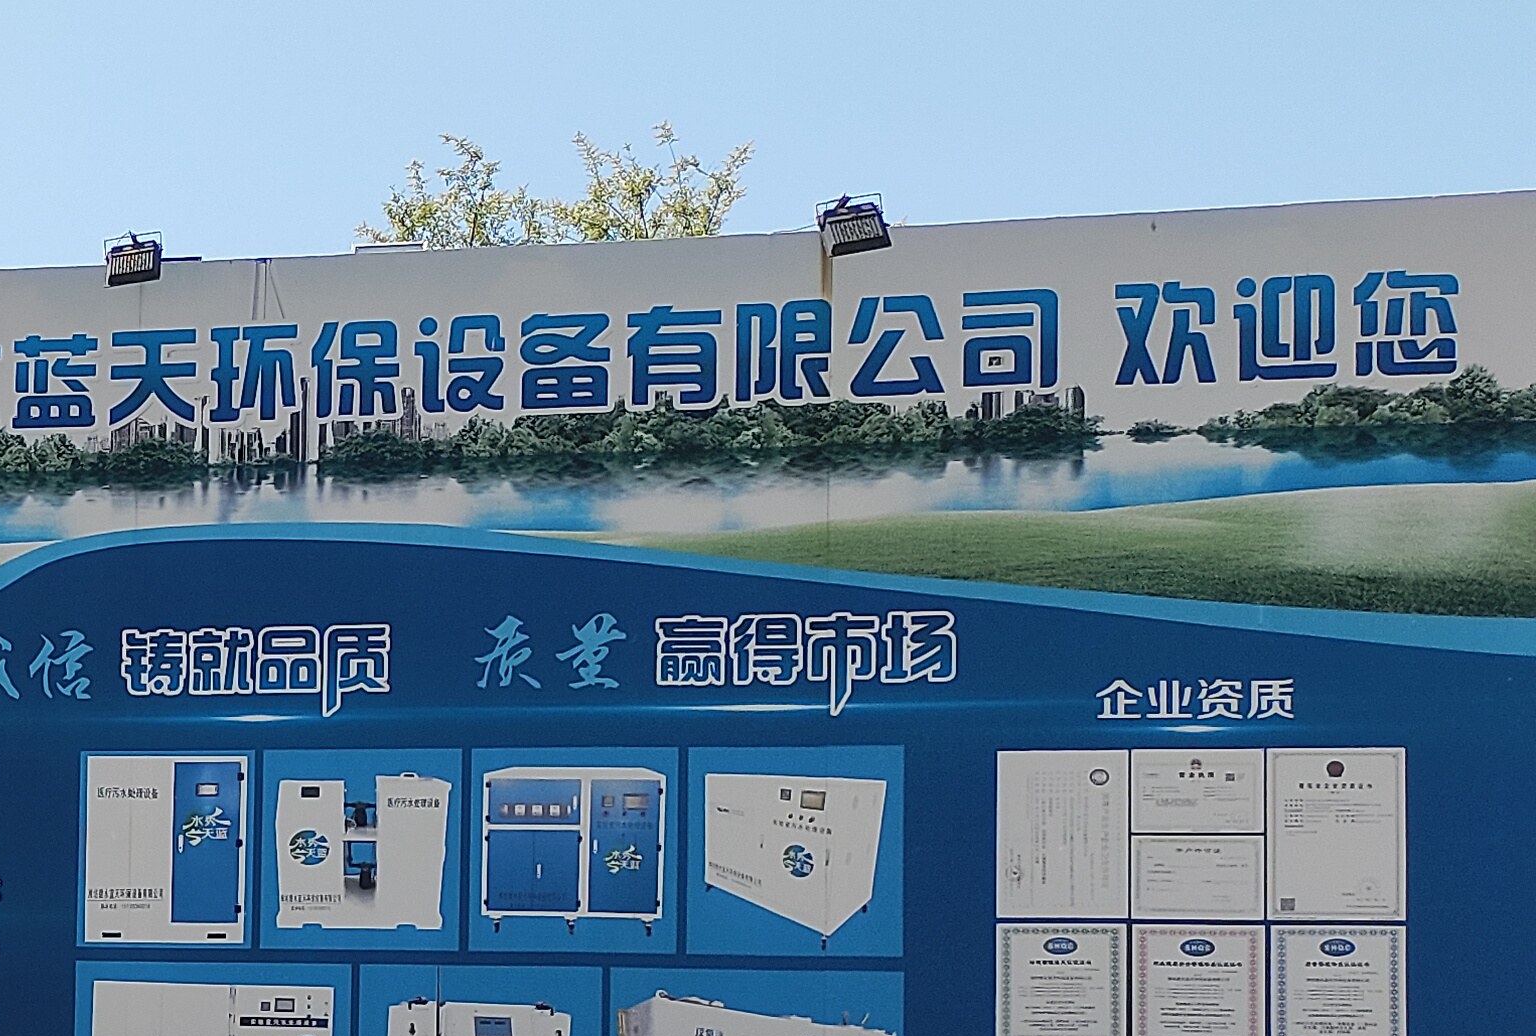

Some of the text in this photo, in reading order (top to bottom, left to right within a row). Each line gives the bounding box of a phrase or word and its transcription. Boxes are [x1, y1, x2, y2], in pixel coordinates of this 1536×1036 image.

[1114, 270, 1460, 388] 欢迎您
[121, 623, 391, 718] 铸就品质
[654, 610, 958, 717] 赢得市场
[1095, 677, 1295, 720] 企业资质
